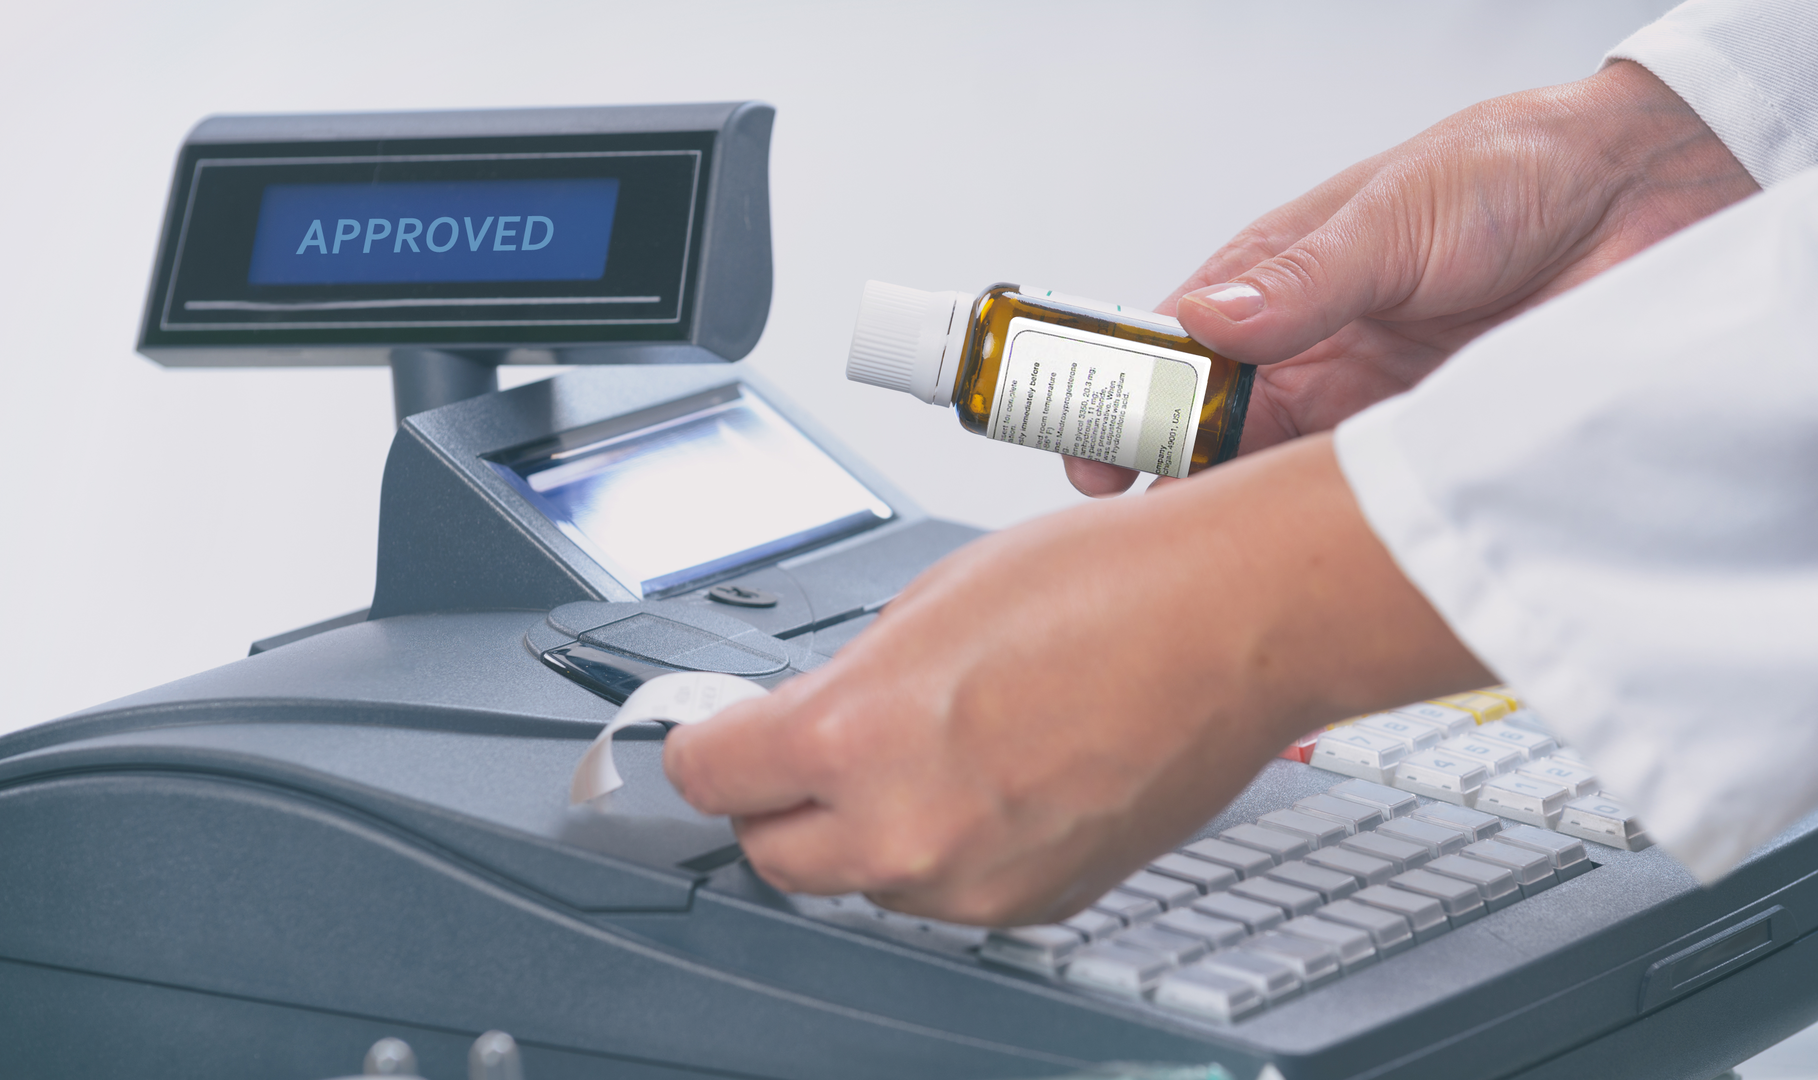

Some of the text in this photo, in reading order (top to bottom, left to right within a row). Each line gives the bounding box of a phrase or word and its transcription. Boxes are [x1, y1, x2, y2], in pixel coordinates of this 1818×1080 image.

[296, 215, 554, 255] APPROVED
[1021, 387, 1036, 431] immediately
[1030, 362, 1040, 386] before
[1043, 372, 1057, 414] temperature
[1083, 381, 1092, 397] 20.3
[1107, 381, 1116, 400] When
[1057, 362, 1077, 438] Medroxyprogesterone
[1079, 399, 1089, 419] 3350,
[1107, 414, 1118, 445] adjusted
[1116, 372, 1125, 397] sodium
[1098, 403, 1112, 447] preservative.
[1112, 410, 1125, 453] hydrochloric
[1121, 393, 1129, 409] acid.
[1172, 408, 1181, 424] USA
[1075, 419, 1084, 441] glycol
[1081, 418, 1093, 454] anhydrous,
[1088, 406, 1094, 414] 11
[1168, 426, 1178, 449] 49001,
[1097, 448, 1102, 456] as
[1349, 735, 1371, 745] 7
[1463, 744, 1490, 755] 5
[1434, 759, 1455, 768] 4
[1546, 767, 1573, 778] 2
[1514, 782, 1538, 790] 1
